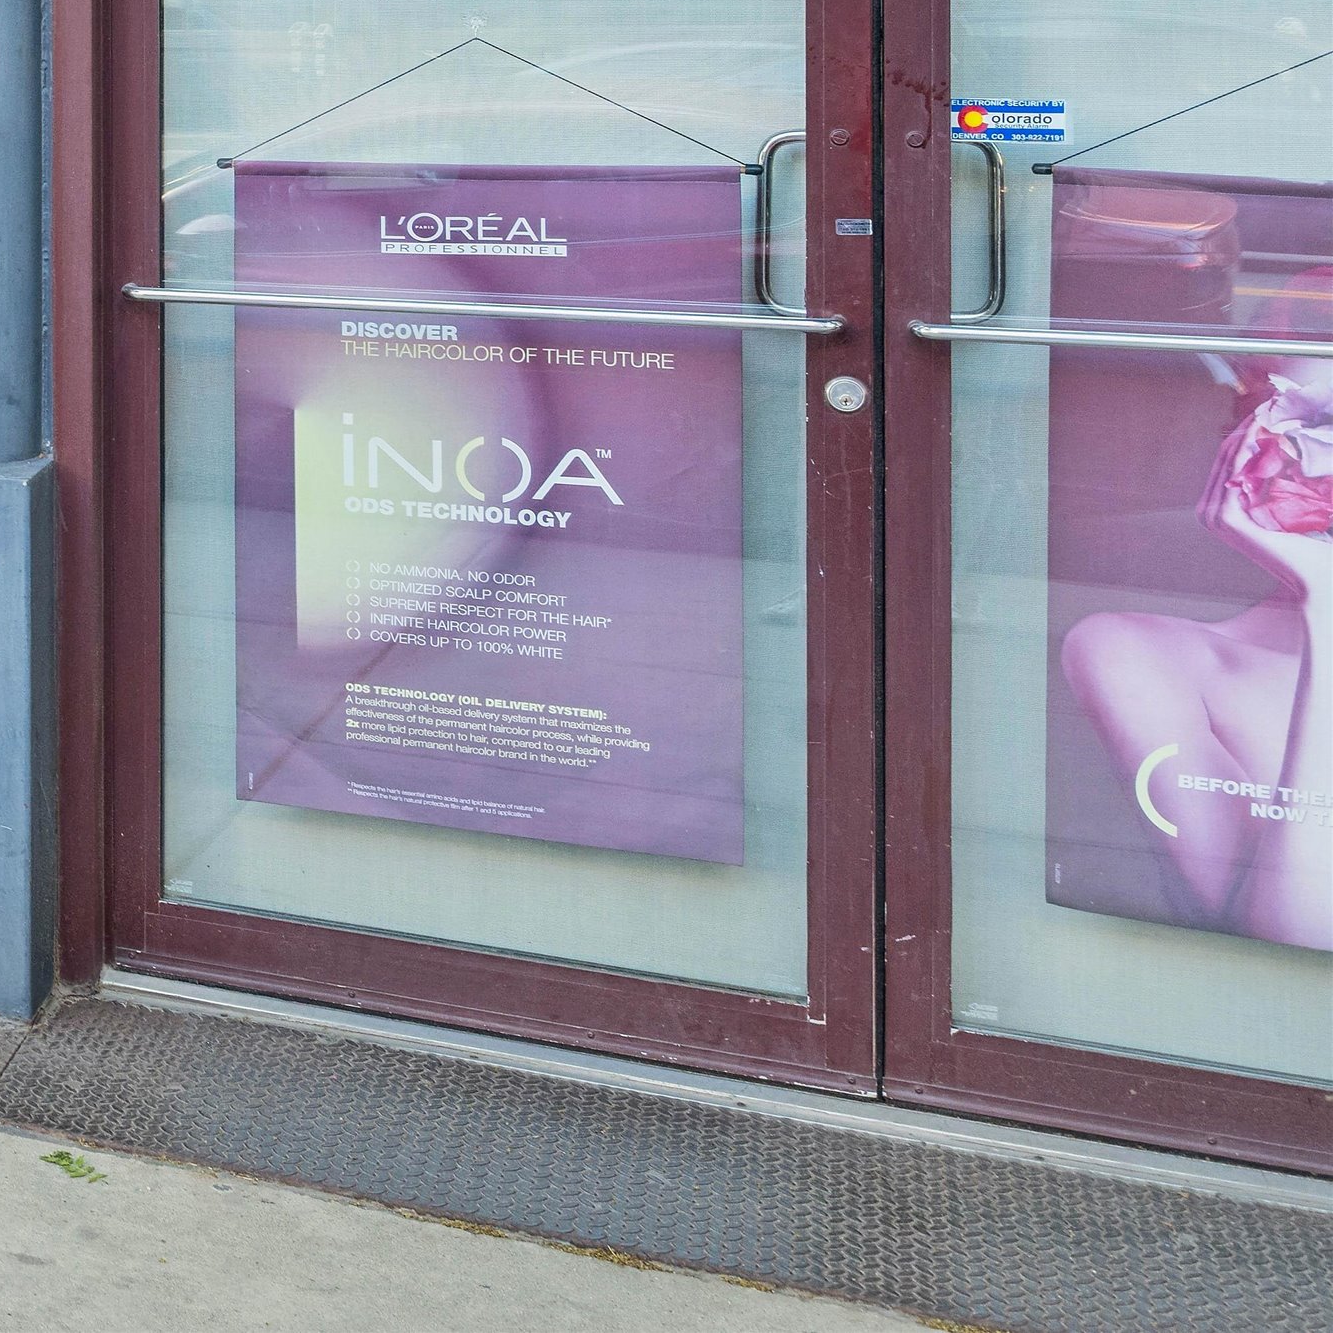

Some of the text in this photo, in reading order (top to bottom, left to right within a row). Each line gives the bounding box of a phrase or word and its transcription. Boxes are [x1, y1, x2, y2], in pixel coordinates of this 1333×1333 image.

[953, 133, 989, 141] DENVER,
[385, 243, 564, 256] PROFESSIONNEL
[341, 321, 458, 341] DISCOVER
[340, 340, 675, 369] THE HAIRCOLOR OF THE FUTURE
[344, 496, 572, 528] ODS TECHNOLOGY
[370, 562, 391, 574] NO
[468, 570, 489, 583] NO
[493, 573, 536, 587] ODOR
[370, 579, 567, 607] OPTIMIZED SCALP COMFORT
[370, 596, 436, 613] SUPREME
[440, 603, 504, 619] RESPECT
[508, 609, 537, 623] FOR
[541, 611, 569, 626] THE
[370, 613, 567, 643] INFINITE HAIRCOLOR POWER
[370, 630, 563, 660] COVERS UP TO 100% WHITE
[345, 683, 607, 721] ODS TECHNOLOGY (OIL DELIVERY SYSTEM):
[345, 694, 631, 735] A breakthrough oil-based delivery system that maximizes the
[345, 706, 650, 752] effectiveness of the permanent haircolor process, while providing
[345, 718, 611, 759] 2x more lipid protection to hair, compared to our leading
[346, 731, 401, 745] professional
[402, 737, 454, 751] permanent
[455, 744, 496, 757] haircolor
[498, 749, 527, 760] brand
[529, 752, 539, 761] in
[540, 754, 556, 764] the
[1177, 774, 1271, 799] BEFORE
[1251, 802, 1307, 823] NOW
